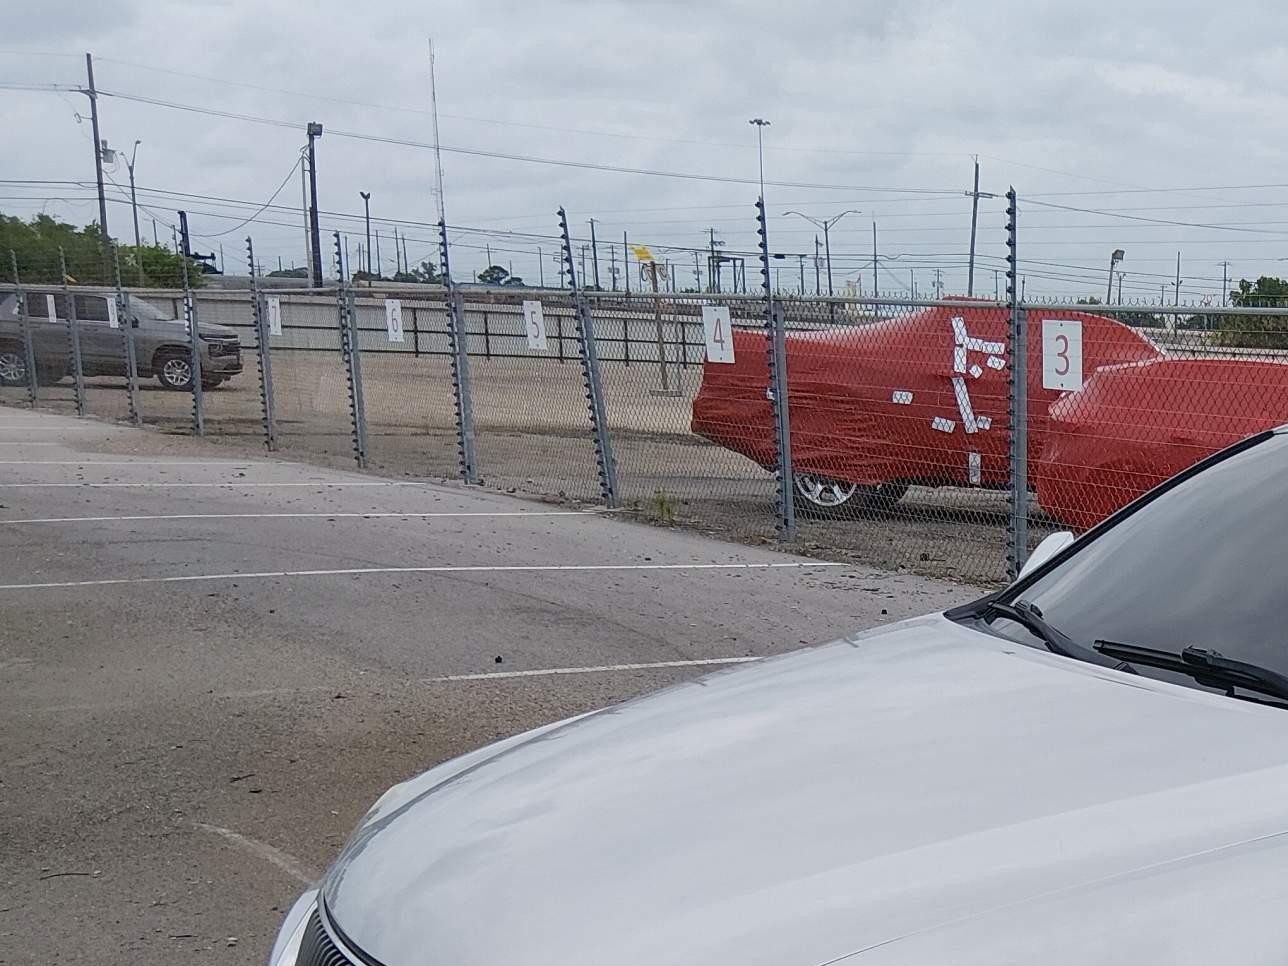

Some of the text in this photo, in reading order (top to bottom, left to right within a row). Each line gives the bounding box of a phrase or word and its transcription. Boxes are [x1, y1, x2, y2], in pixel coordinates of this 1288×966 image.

[391, 308, 399, 333] 6
[530, 310, 540, 339] 5
[713, 318, 725, 351] 4
[1054, 334, 1070, 376] 3
